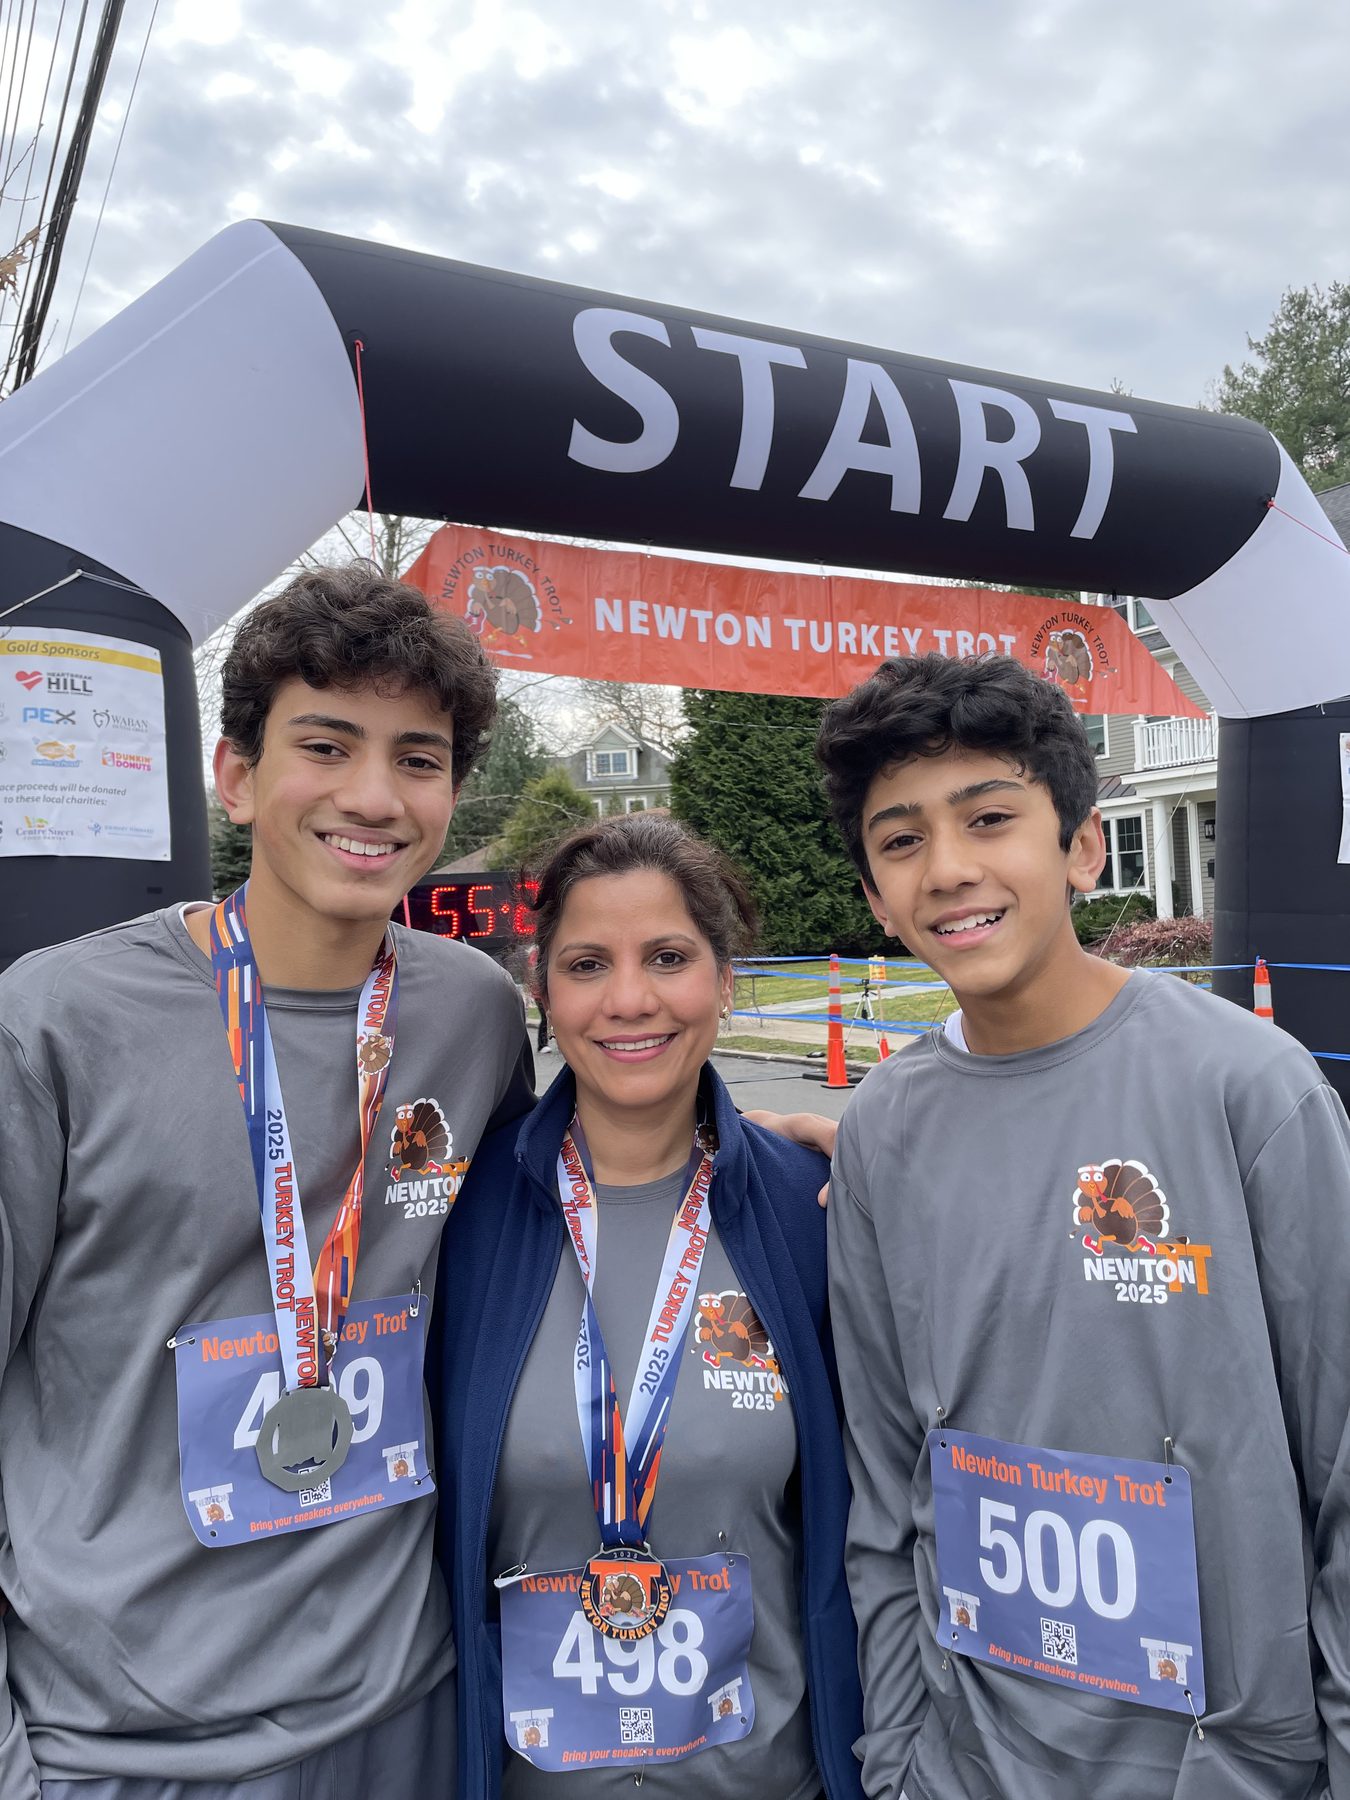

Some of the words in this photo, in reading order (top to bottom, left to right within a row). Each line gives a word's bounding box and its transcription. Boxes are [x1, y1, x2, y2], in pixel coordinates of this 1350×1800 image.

[566, 307, 1138, 540] START
[442, 546, 485, 599] NEWTON
[488, 544, 541, 574] TURKEY
[541, 576, 562, 614] TROT
[7, 641, 39, 653] Gold
[41, 643, 100, 660] Sponsors
[595, 597, 772, 648] NEWTON
[783, 618, 922, 657] TURKEY
[933, 629, 1017, 661] TROT
[1030, 615, 1059, 658] NEWTON
[1061, 612, 1094, 634] TURKEY
[1093, 635, 1109, 666] TROT
[48, 678, 93, 692] HILL
[23, 707, 76, 725] PEX
[0, 784, 15, 792] ace
[16, 782, 58, 793] proceeds
[60, 783, 77, 791] will
[79, 784, 90, 792] be
[91, 785, 127, 796] donated
[116, 760, 152, 772] DONUTS
[4, 796, 14, 804] to
[16, 795, 41, 803] these
[43, 795, 64, 804] local
[66, 795, 107, 806] charities:
[364, 951, 395, 1028] NEWTON
[266, 1109, 285, 1160] 2025
[561, 1138, 592, 1208] NEWTON
[677, 1157, 714, 1232] NEWTON
[274, 1162, 295, 1250] TURKEY
[403, 1198, 448, 1219] 2025
[562, 1200, 590, 1268] TURKEY
[679, 1225, 710, 1271] TROT
[275, 1253, 296, 1312] TROT
[1083, 1258, 1196, 1284] NEWTON
[1114, 1282, 1168, 1304] 2025
[651, 1270, 692, 1343] TURKEY
[202, 1331, 280, 1362] Newto
[373, 1310, 408, 1336] Trot
[639, 1347, 670, 1396] 2025
[703, 1370, 789, 1393] NEWTON
[233, 1356, 385, 1450] 49
[731, 1391, 775, 1411] 2025
[951, 1445, 1021, 1486] Newton
[1027, 1463, 1108, 1504] Turkey
[1114, 1475, 1167, 1508] Trot
[250, 1520, 273, 1533] Bring
[274, 1516, 292, 1529] your
[294, 1507, 332, 1523] sneakers
[334, 1493, 385, 1513] everywhere.
[520, 1573, 580, 1593] Newt
[687, 1567, 731, 1591] Trot
[979, 1497, 1137, 1620] 500
[581, 1580, 609, 1633] NEWTON
[612, 1619, 657, 1640] TURKEY
[655, 1585, 670, 1618] TROT
[553, 1609, 709, 1696] 498
[988, 1643, 1011, 1663] Bring
[1012, 1653, 1033, 1668] your
[1034, 1660, 1077, 1680] sneakers
[1078, 1672, 1140, 1695] everywhere.
[562, 1751, 587, 1764] Bring
[589, 1749, 609, 1762] your
[612, 1747, 654, 1758] sneakes
[656, 1735, 707, 1757] everywhere.
